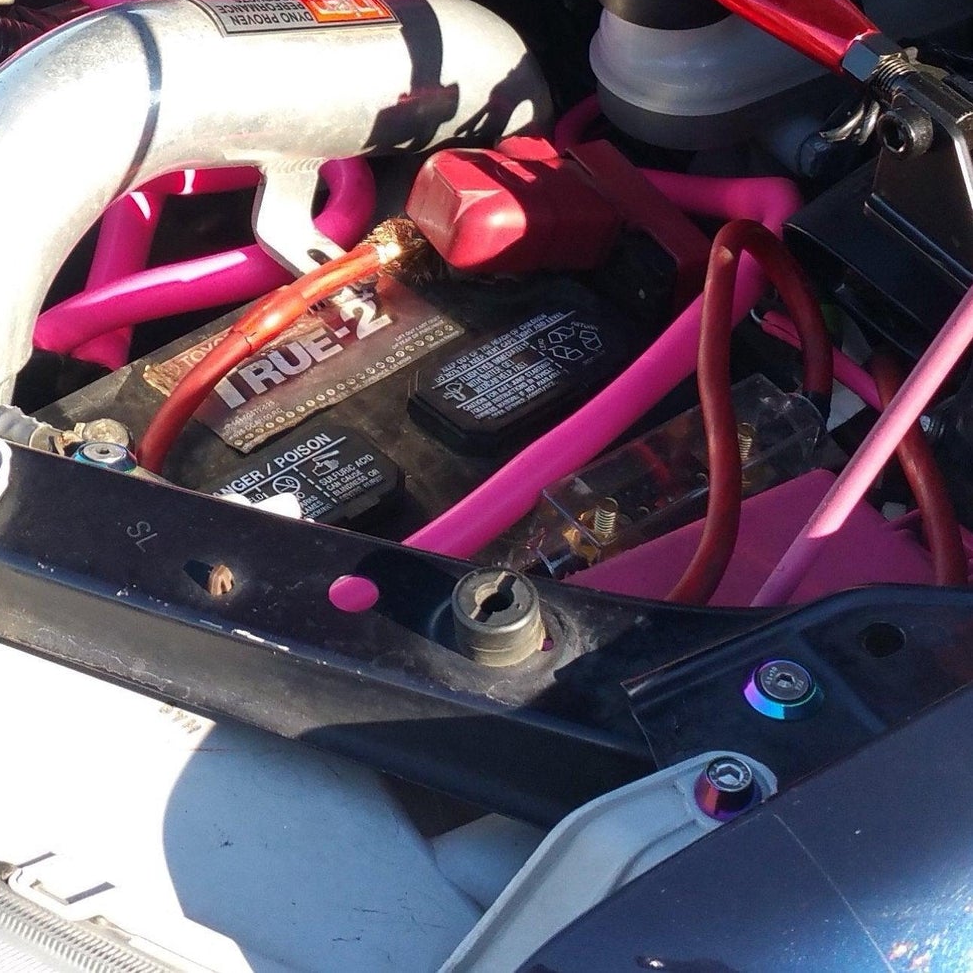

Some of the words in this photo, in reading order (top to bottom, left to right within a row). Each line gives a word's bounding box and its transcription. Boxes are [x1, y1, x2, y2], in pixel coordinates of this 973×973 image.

[216, 0, 302, 14] PERFORMANCE
[230, 12, 277, 26] PROVEN
[281, 11, 314, 23] DYNO
[273, 433, 332, 468] POISON
[318, 462, 355, 486] SULFURIC
[354, 454, 374, 467] ACID
[340, 469, 363, 483] CAUSE
